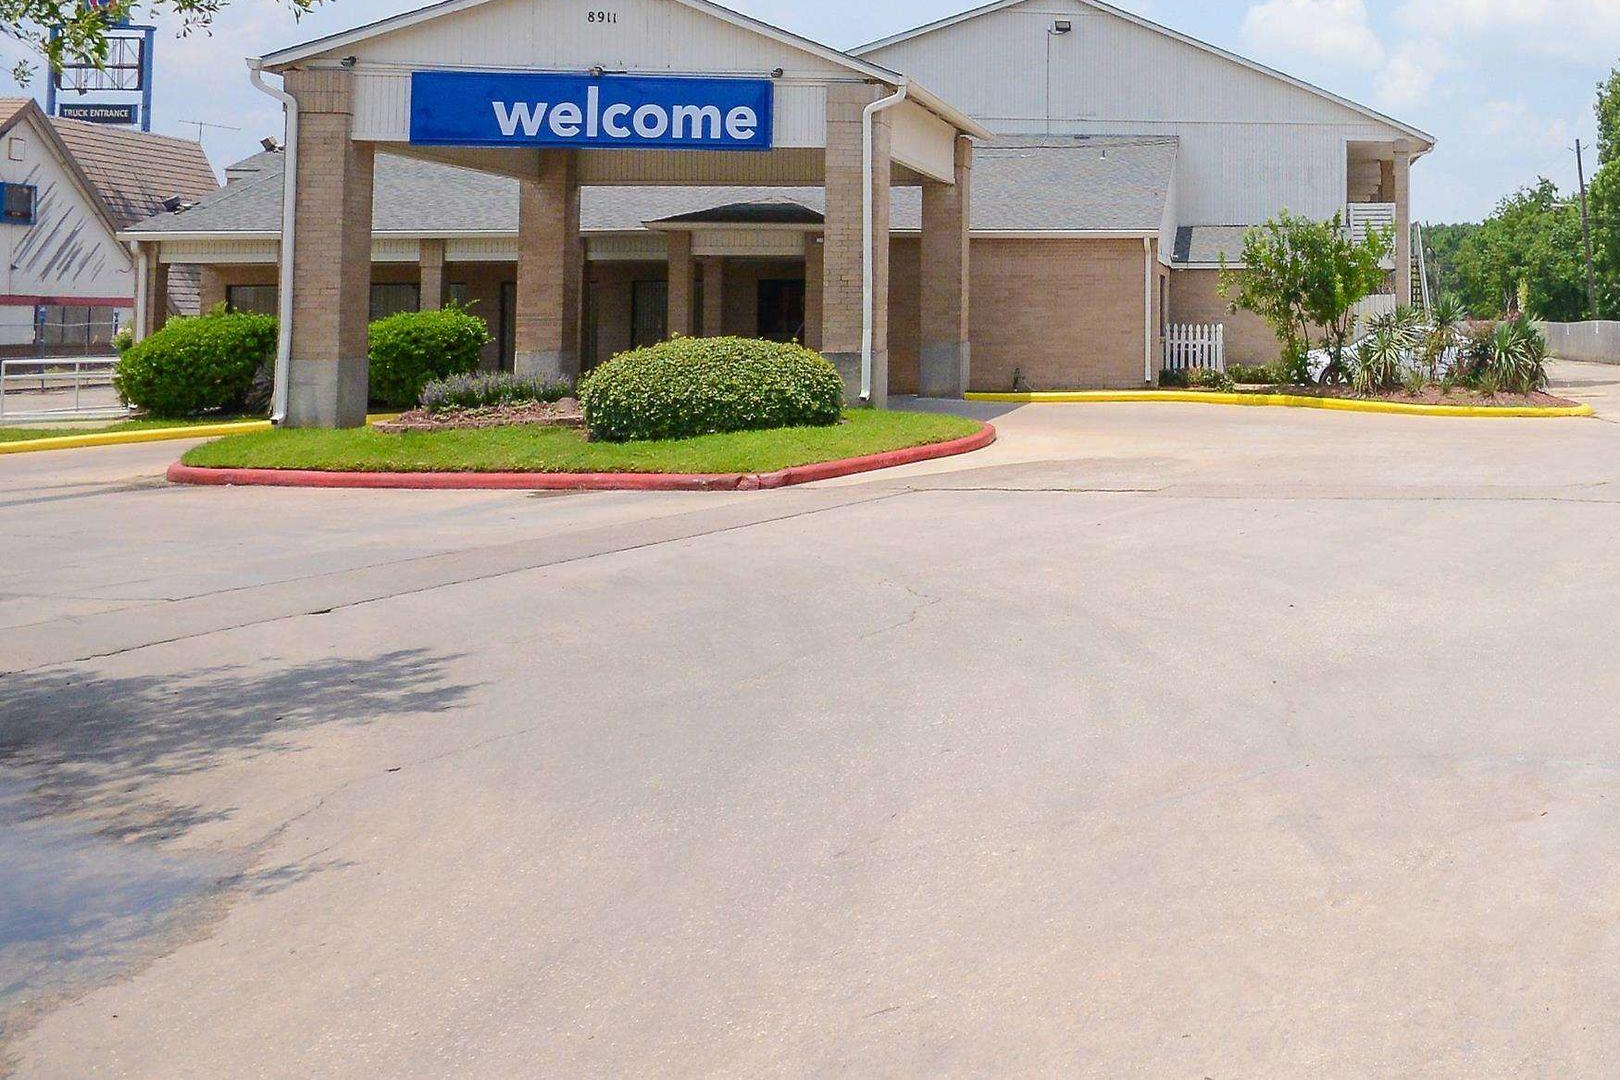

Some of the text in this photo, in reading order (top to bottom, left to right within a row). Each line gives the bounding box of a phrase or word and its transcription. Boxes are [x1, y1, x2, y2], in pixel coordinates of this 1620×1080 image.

[587, 11, 617, 23] 8911
[64, 108, 129, 118] TRUCK ENTRANCE
[491, 85, 758, 140] welcome
